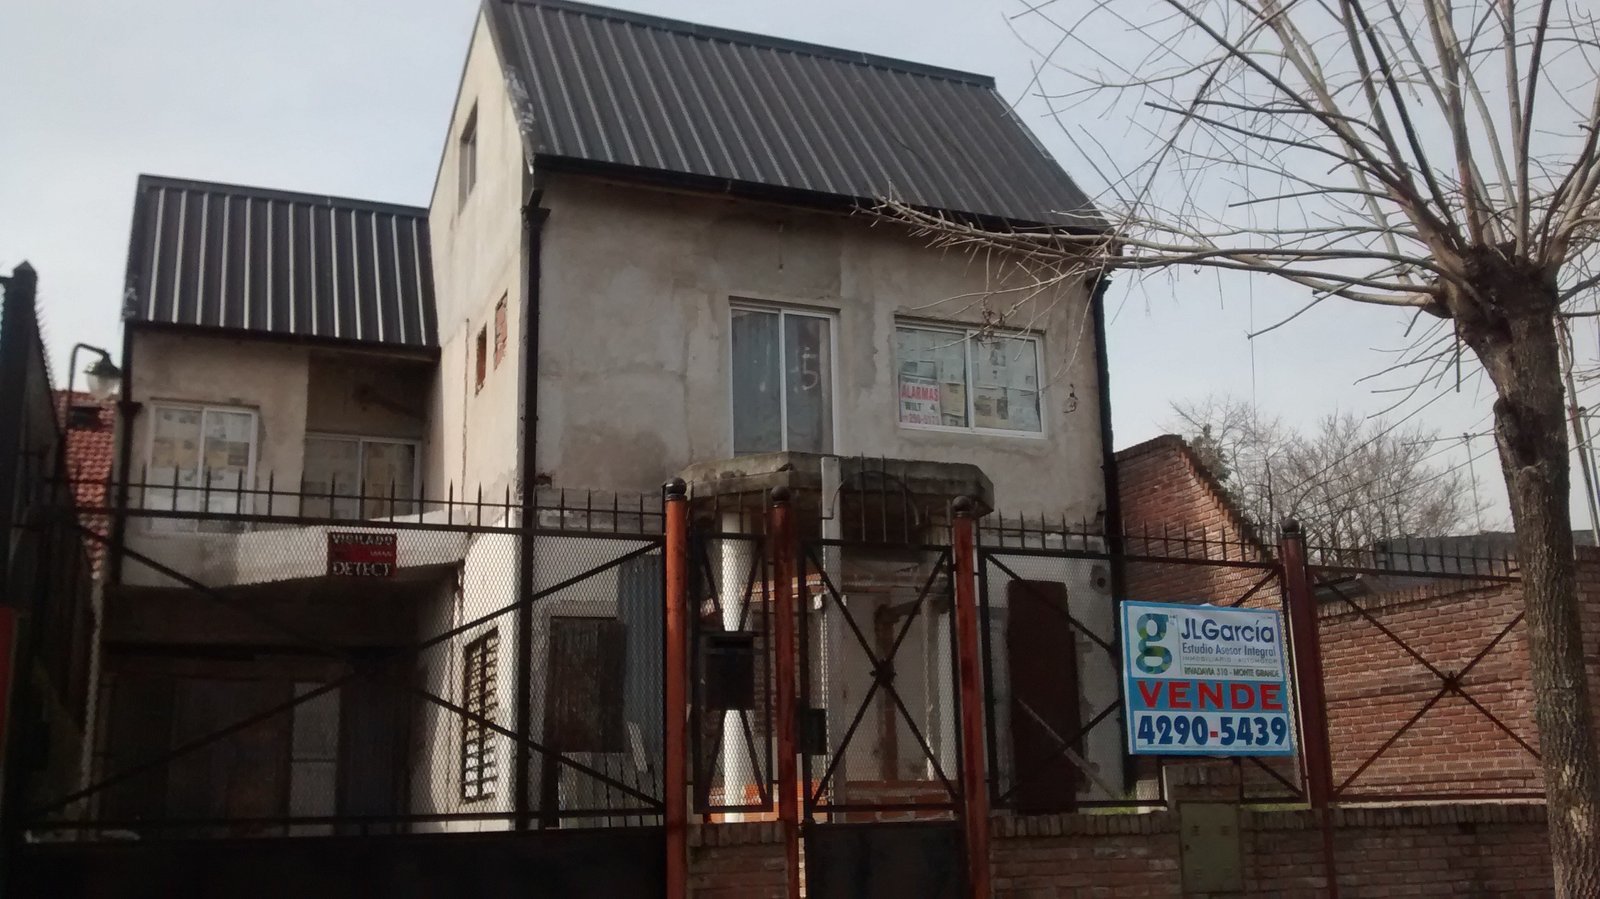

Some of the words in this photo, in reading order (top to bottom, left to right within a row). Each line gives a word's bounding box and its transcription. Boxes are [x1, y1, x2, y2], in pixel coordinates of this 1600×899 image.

[901, 384, 938, 401] ALARMAS
[332, 534, 393, 545] VIGILADO
[332, 561, 392, 576] DETECT
[1181, 617, 1274, 643] JLGarcía
[1182, 642, 1213, 655] Estudio
[1216, 643, 1241, 656] Asesor
[1244, 645, 1276, 659] Integral
[1184, 667, 1215, 676] RIVADAVIA
[1233, 668, 1254, 677] MONTE
[1256, 669, 1280, 678] GRANDE
[1136, 680, 1283, 710] VENDE
[1137, 715, 1287, 746] 4290-5439
